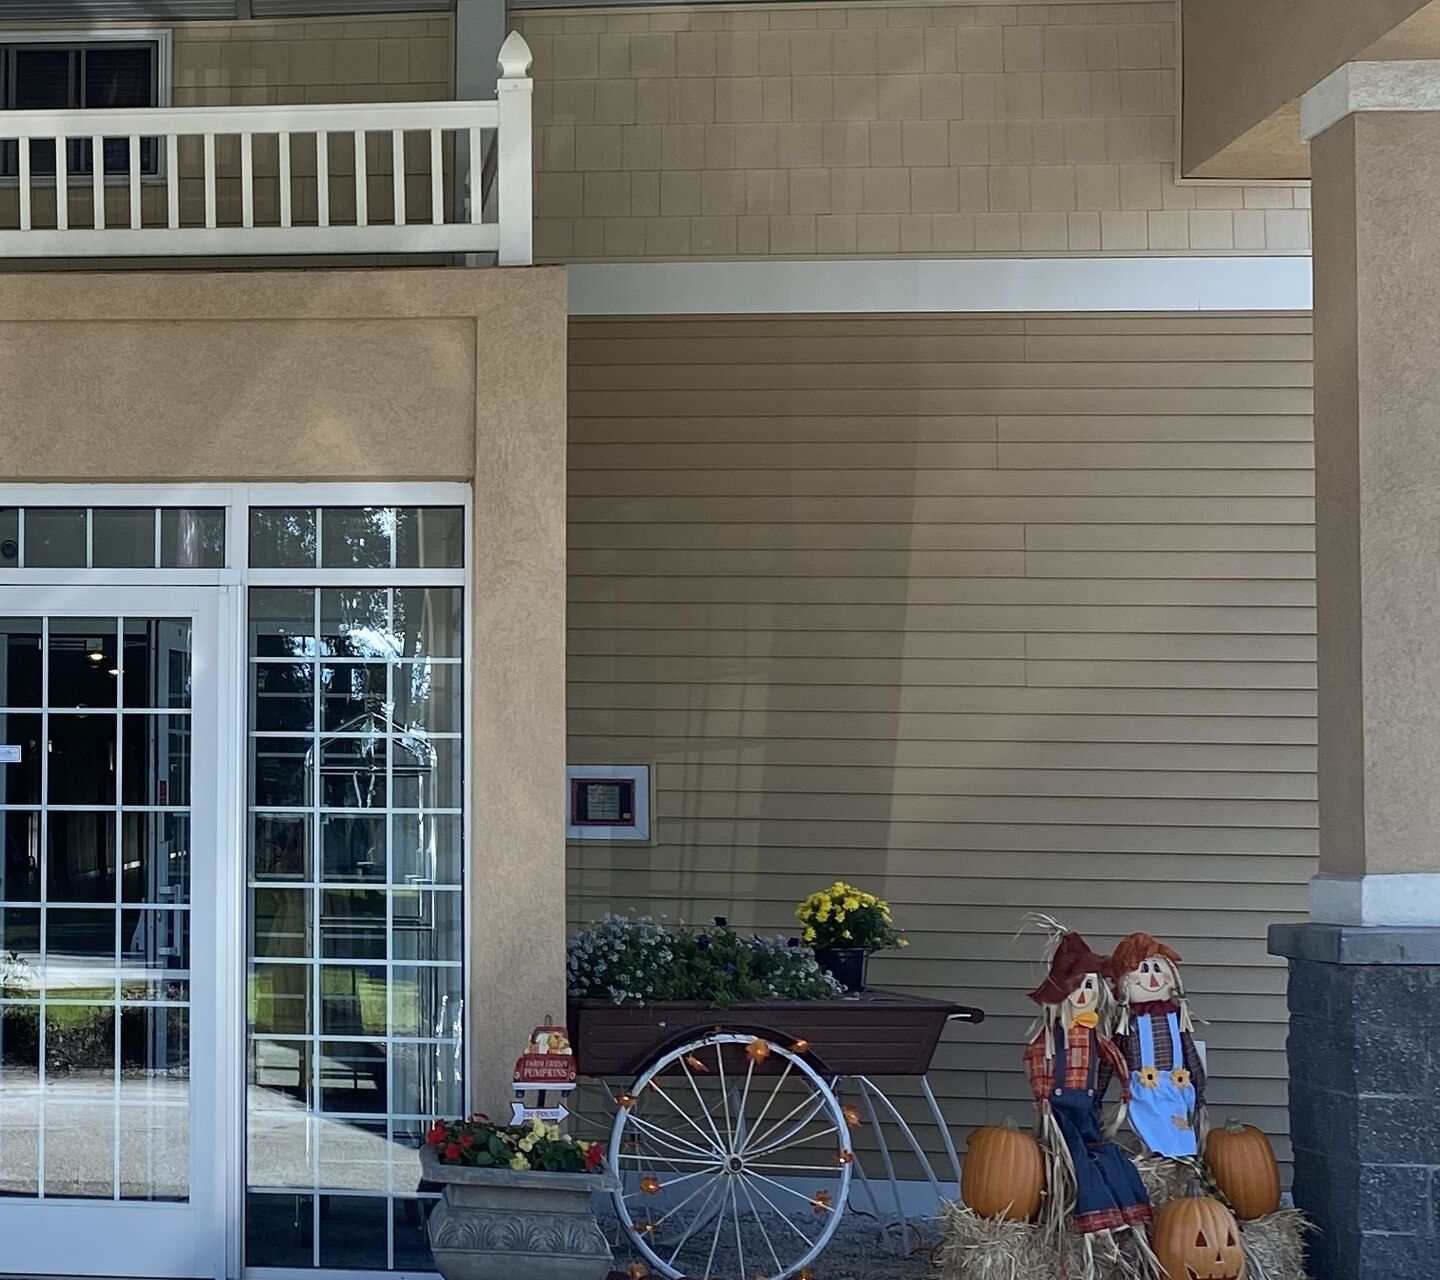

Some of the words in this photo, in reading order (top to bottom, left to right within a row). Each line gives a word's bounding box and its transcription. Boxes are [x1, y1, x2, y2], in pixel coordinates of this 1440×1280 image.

[525, 1059, 544, 1067] FARM
[545, 1059, 568, 1067] FRESH
[523, 1068, 567, 1077] PUMPKINS
